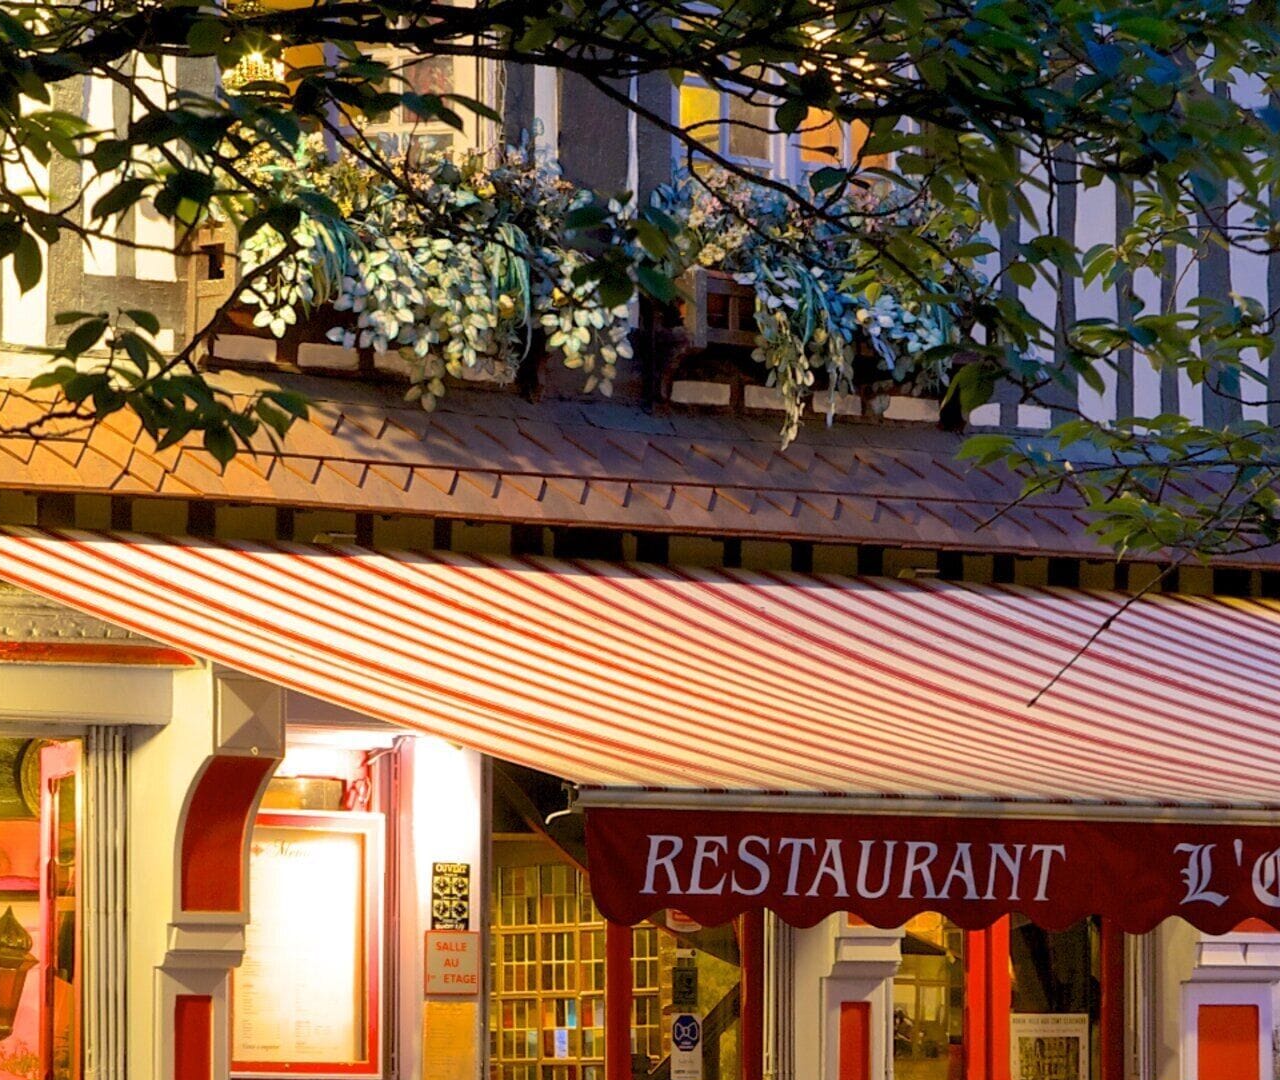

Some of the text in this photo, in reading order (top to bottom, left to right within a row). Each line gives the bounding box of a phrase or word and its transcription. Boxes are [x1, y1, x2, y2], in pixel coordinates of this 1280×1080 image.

[639, 834, 1066, 902] RESTAURANT
[435, 941, 467, 951] SALLE
[443, 958, 459, 968] AU
[443, 974, 477, 985] ETAGE
